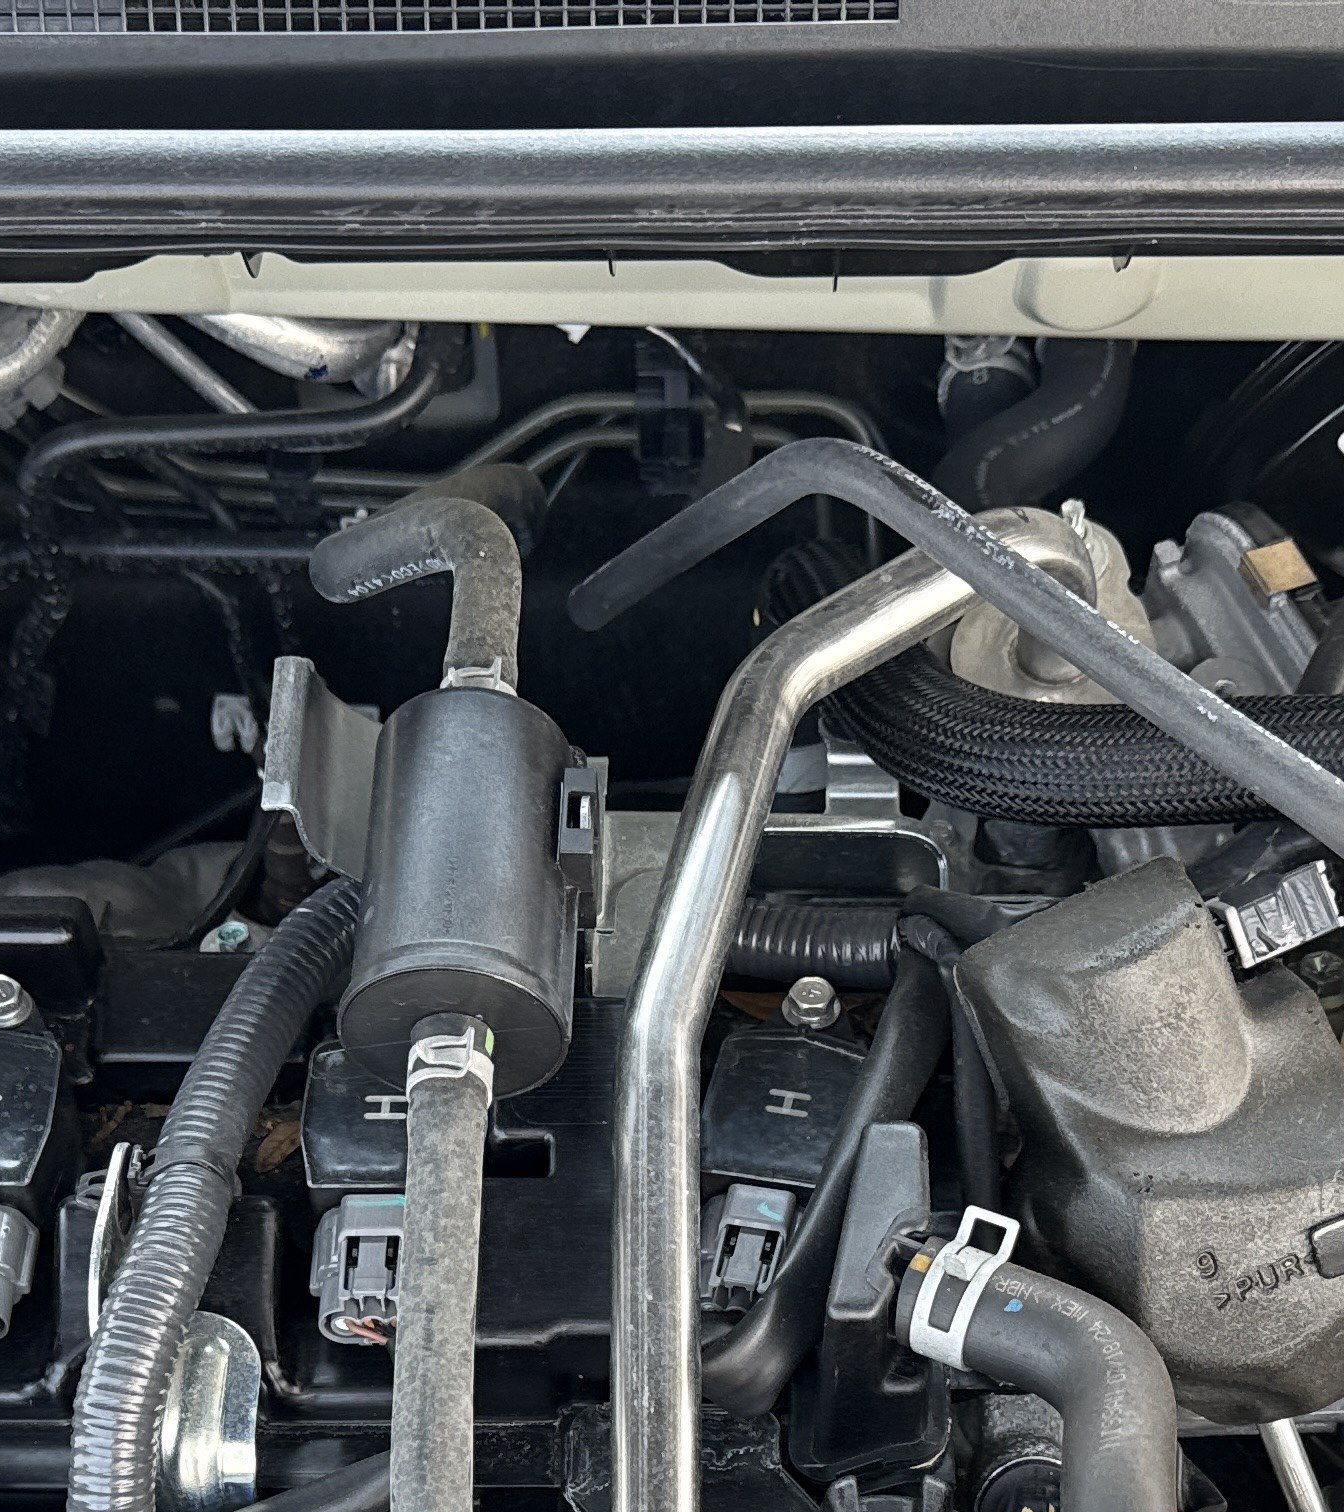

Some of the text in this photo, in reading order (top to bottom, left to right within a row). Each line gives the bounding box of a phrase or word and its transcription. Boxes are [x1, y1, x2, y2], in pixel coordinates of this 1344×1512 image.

[364, 1095, 409, 1119] H
[765, 1088, 811, 1118] H
[1050, 1293, 1090, 1323] MEX
